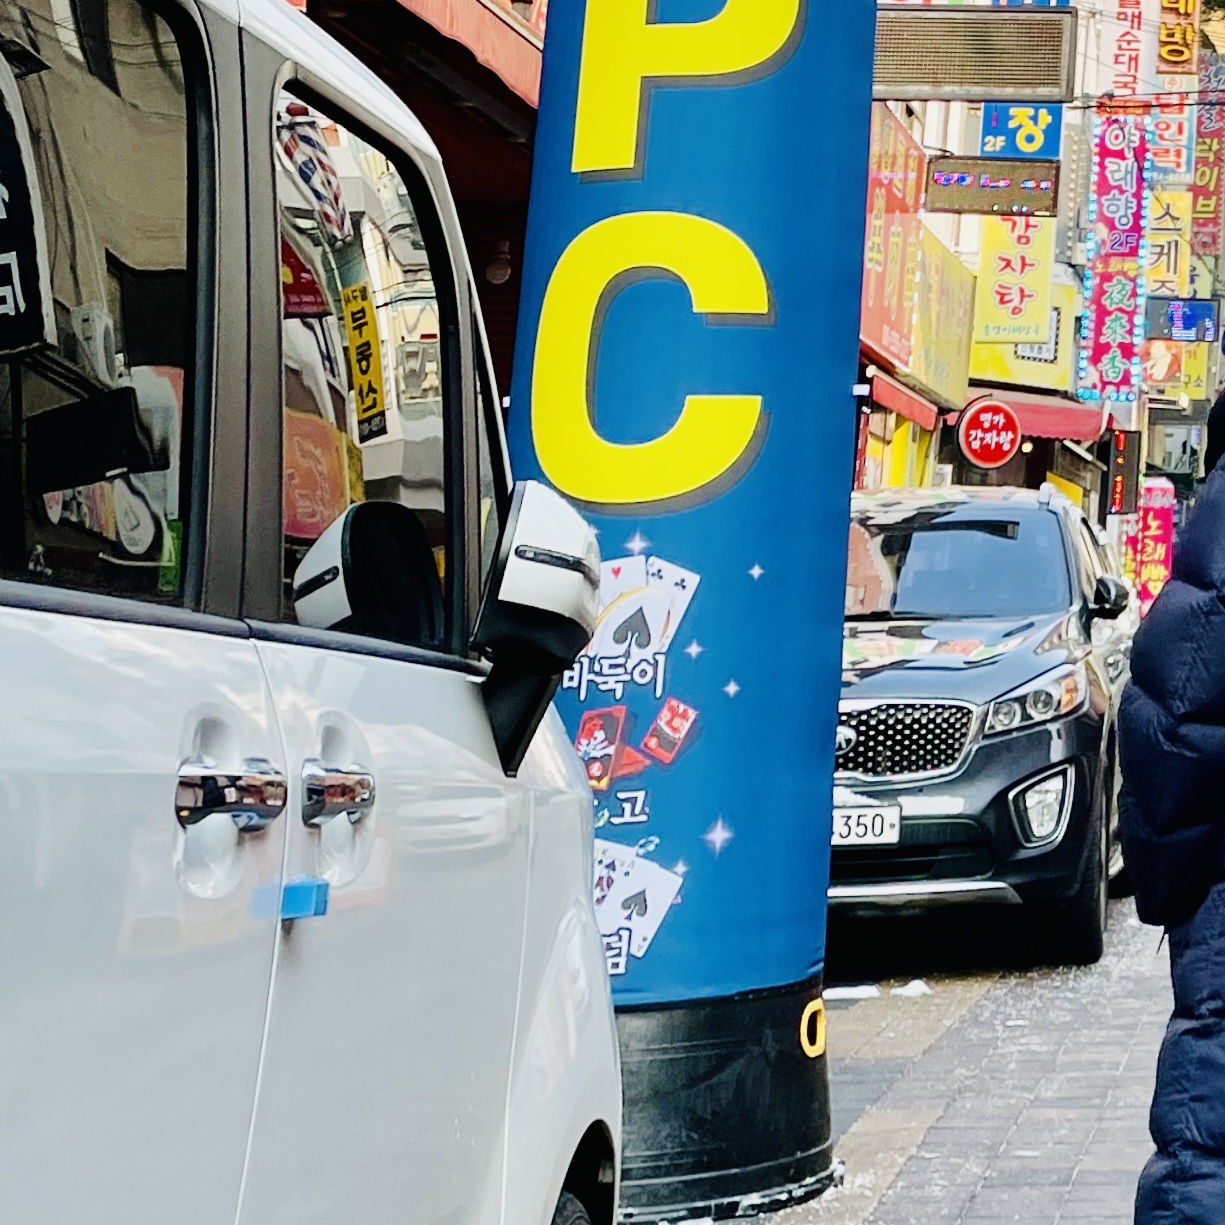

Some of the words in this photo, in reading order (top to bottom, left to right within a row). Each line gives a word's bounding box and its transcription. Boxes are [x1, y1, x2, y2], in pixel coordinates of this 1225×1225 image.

[984, 136, 1006, 151] 2F
[1008, 107, 1052, 152] 장
[1102, 121, 1139, 229] 야래향
[1109, 232, 1137, 252] 2F
[994, 215, 1039, 316] 감자탕
[562, 653, 666, 701] 바둑이
[594, 790, 649, 825] 고
[836, 813, 884, 839] 350
